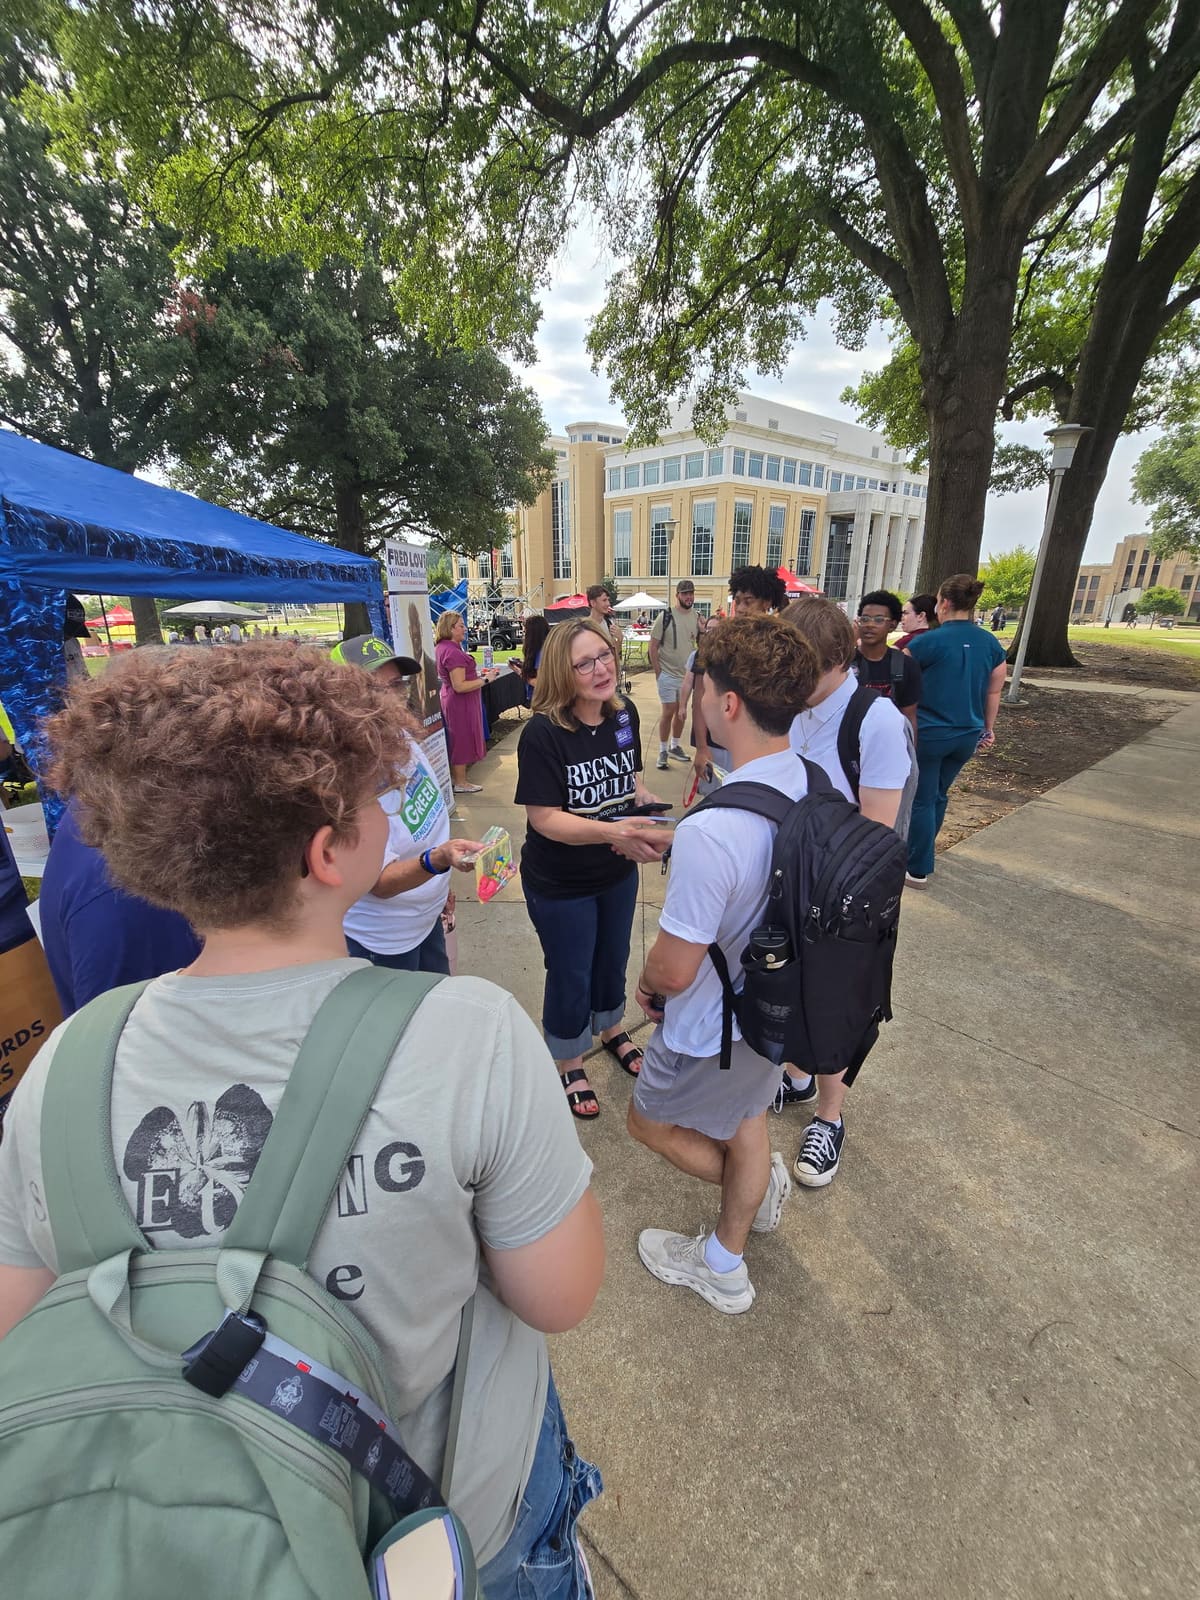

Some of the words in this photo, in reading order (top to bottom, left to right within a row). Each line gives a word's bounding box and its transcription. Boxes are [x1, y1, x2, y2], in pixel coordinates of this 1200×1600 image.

[388, 548, 408, 567] FRED
[565, 748, 635, 787] REGNAT
[405, 777, 437, 825] GREEN
[0, 1019, 45, 1060] RDS
